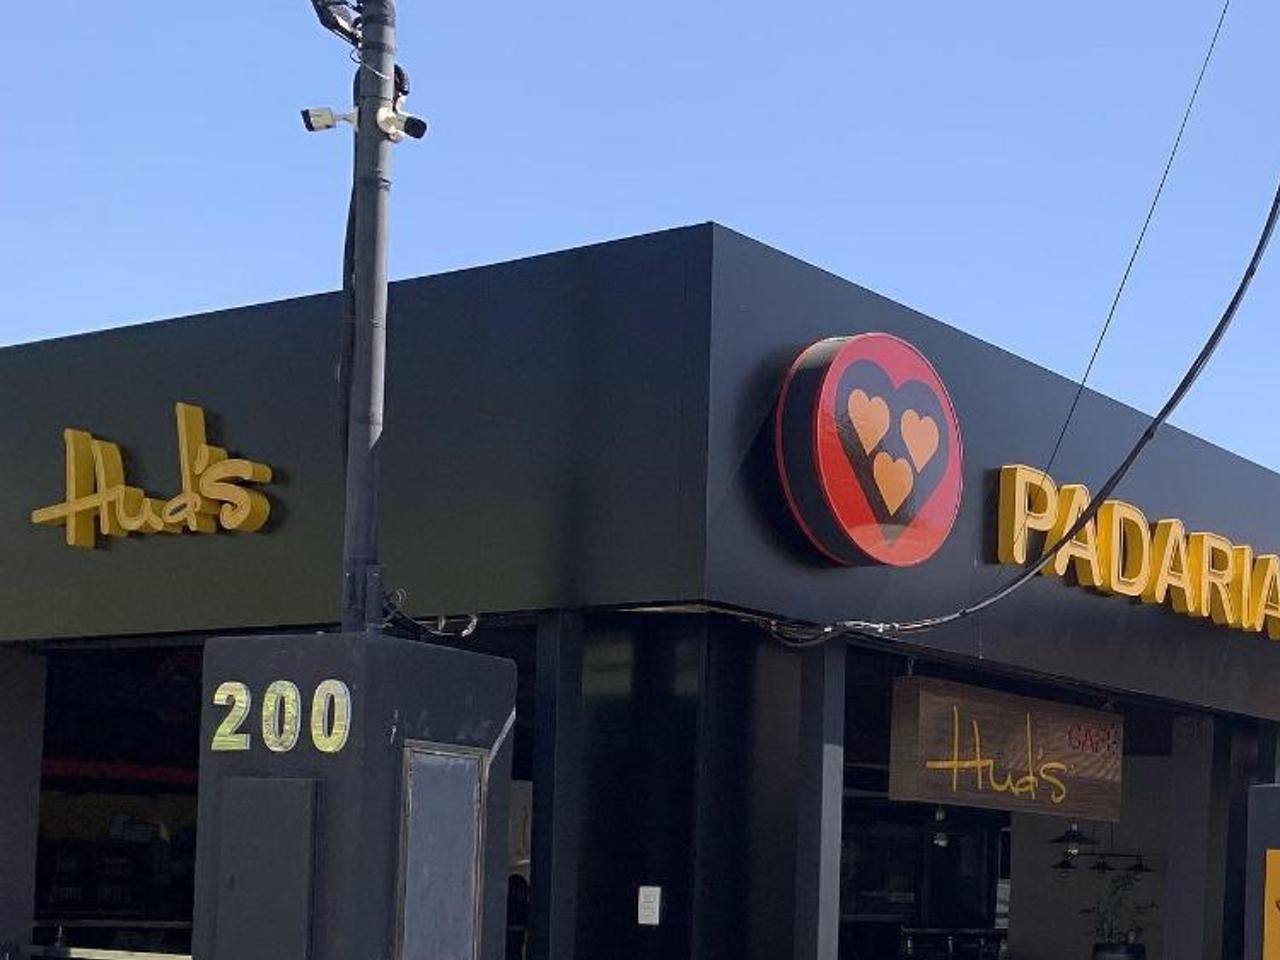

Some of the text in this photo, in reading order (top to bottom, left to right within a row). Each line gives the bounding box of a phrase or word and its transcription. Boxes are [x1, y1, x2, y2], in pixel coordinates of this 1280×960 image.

[30, 402, 273, 549] Hud's
[211, 679, 352, 753] 200
[926, 705, 1067, 804] Hud's
